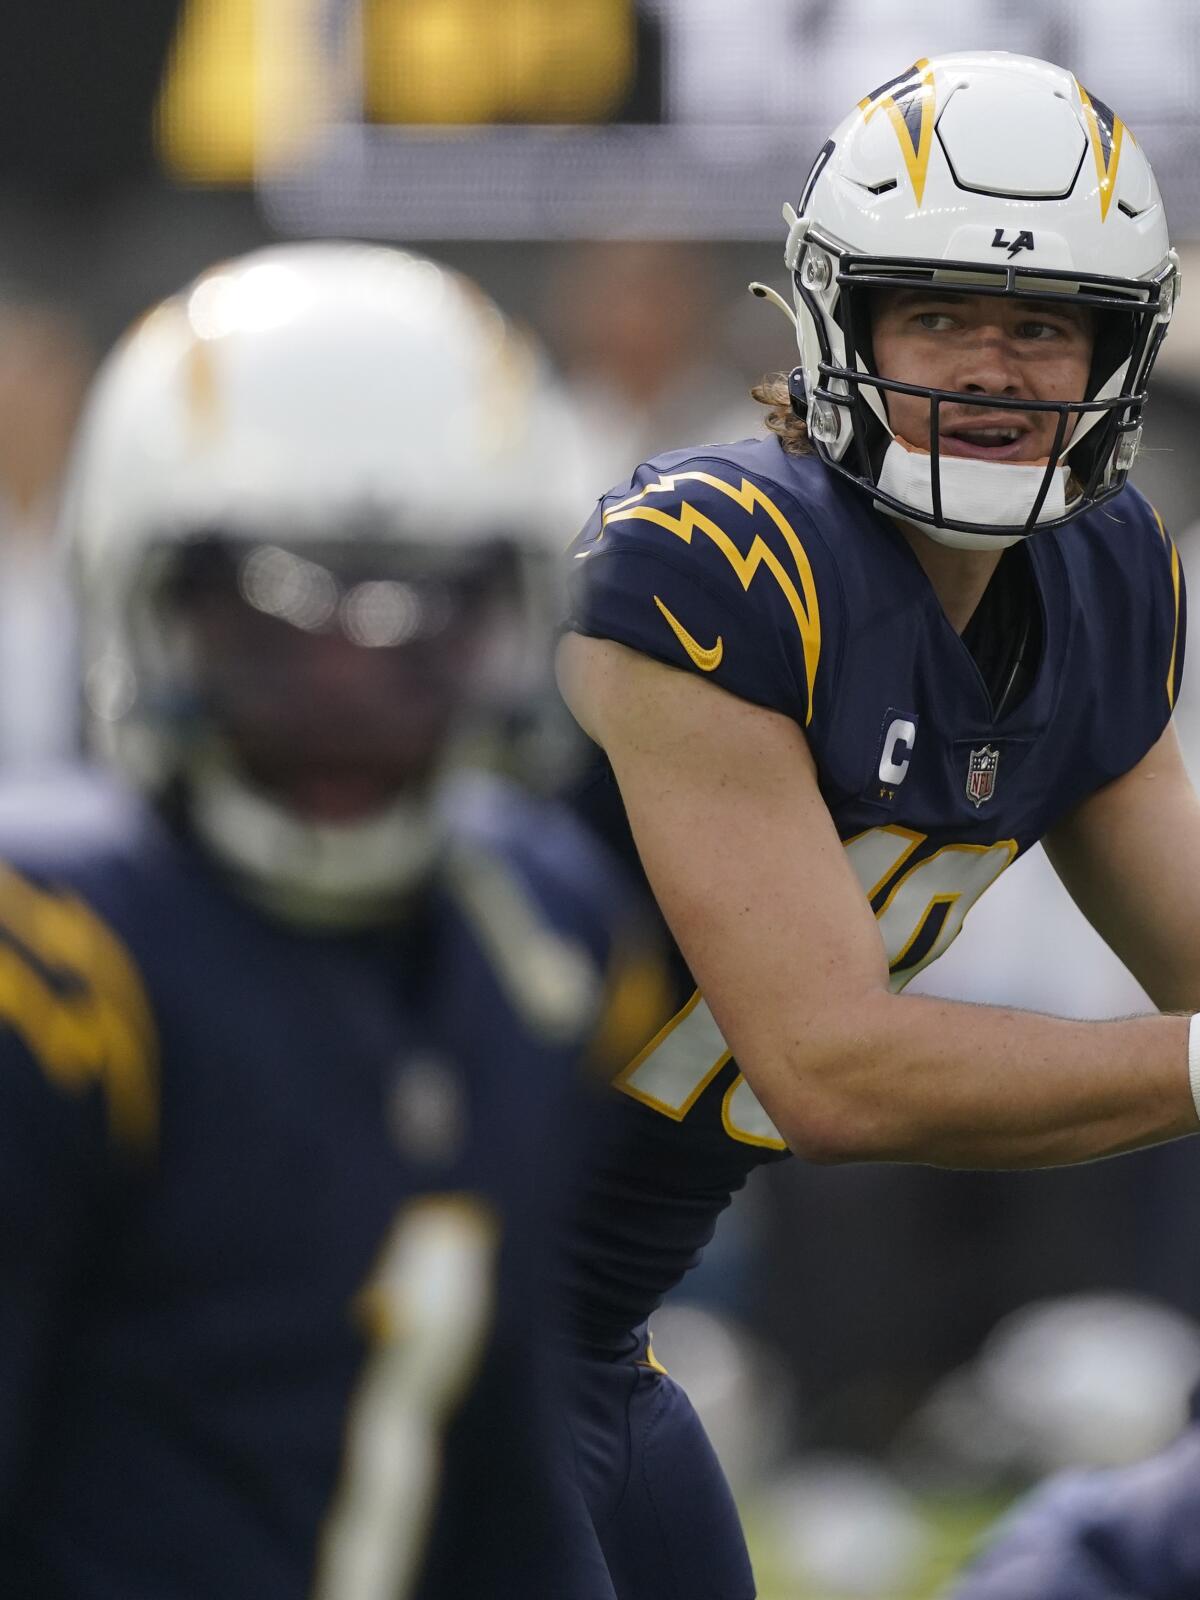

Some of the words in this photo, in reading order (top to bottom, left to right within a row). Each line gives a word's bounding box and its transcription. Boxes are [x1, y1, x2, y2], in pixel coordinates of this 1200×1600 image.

[991, 228, 1035, 260] LA
[878, 718, 916, 786] C
[970, 771, 993, 798] NFL
